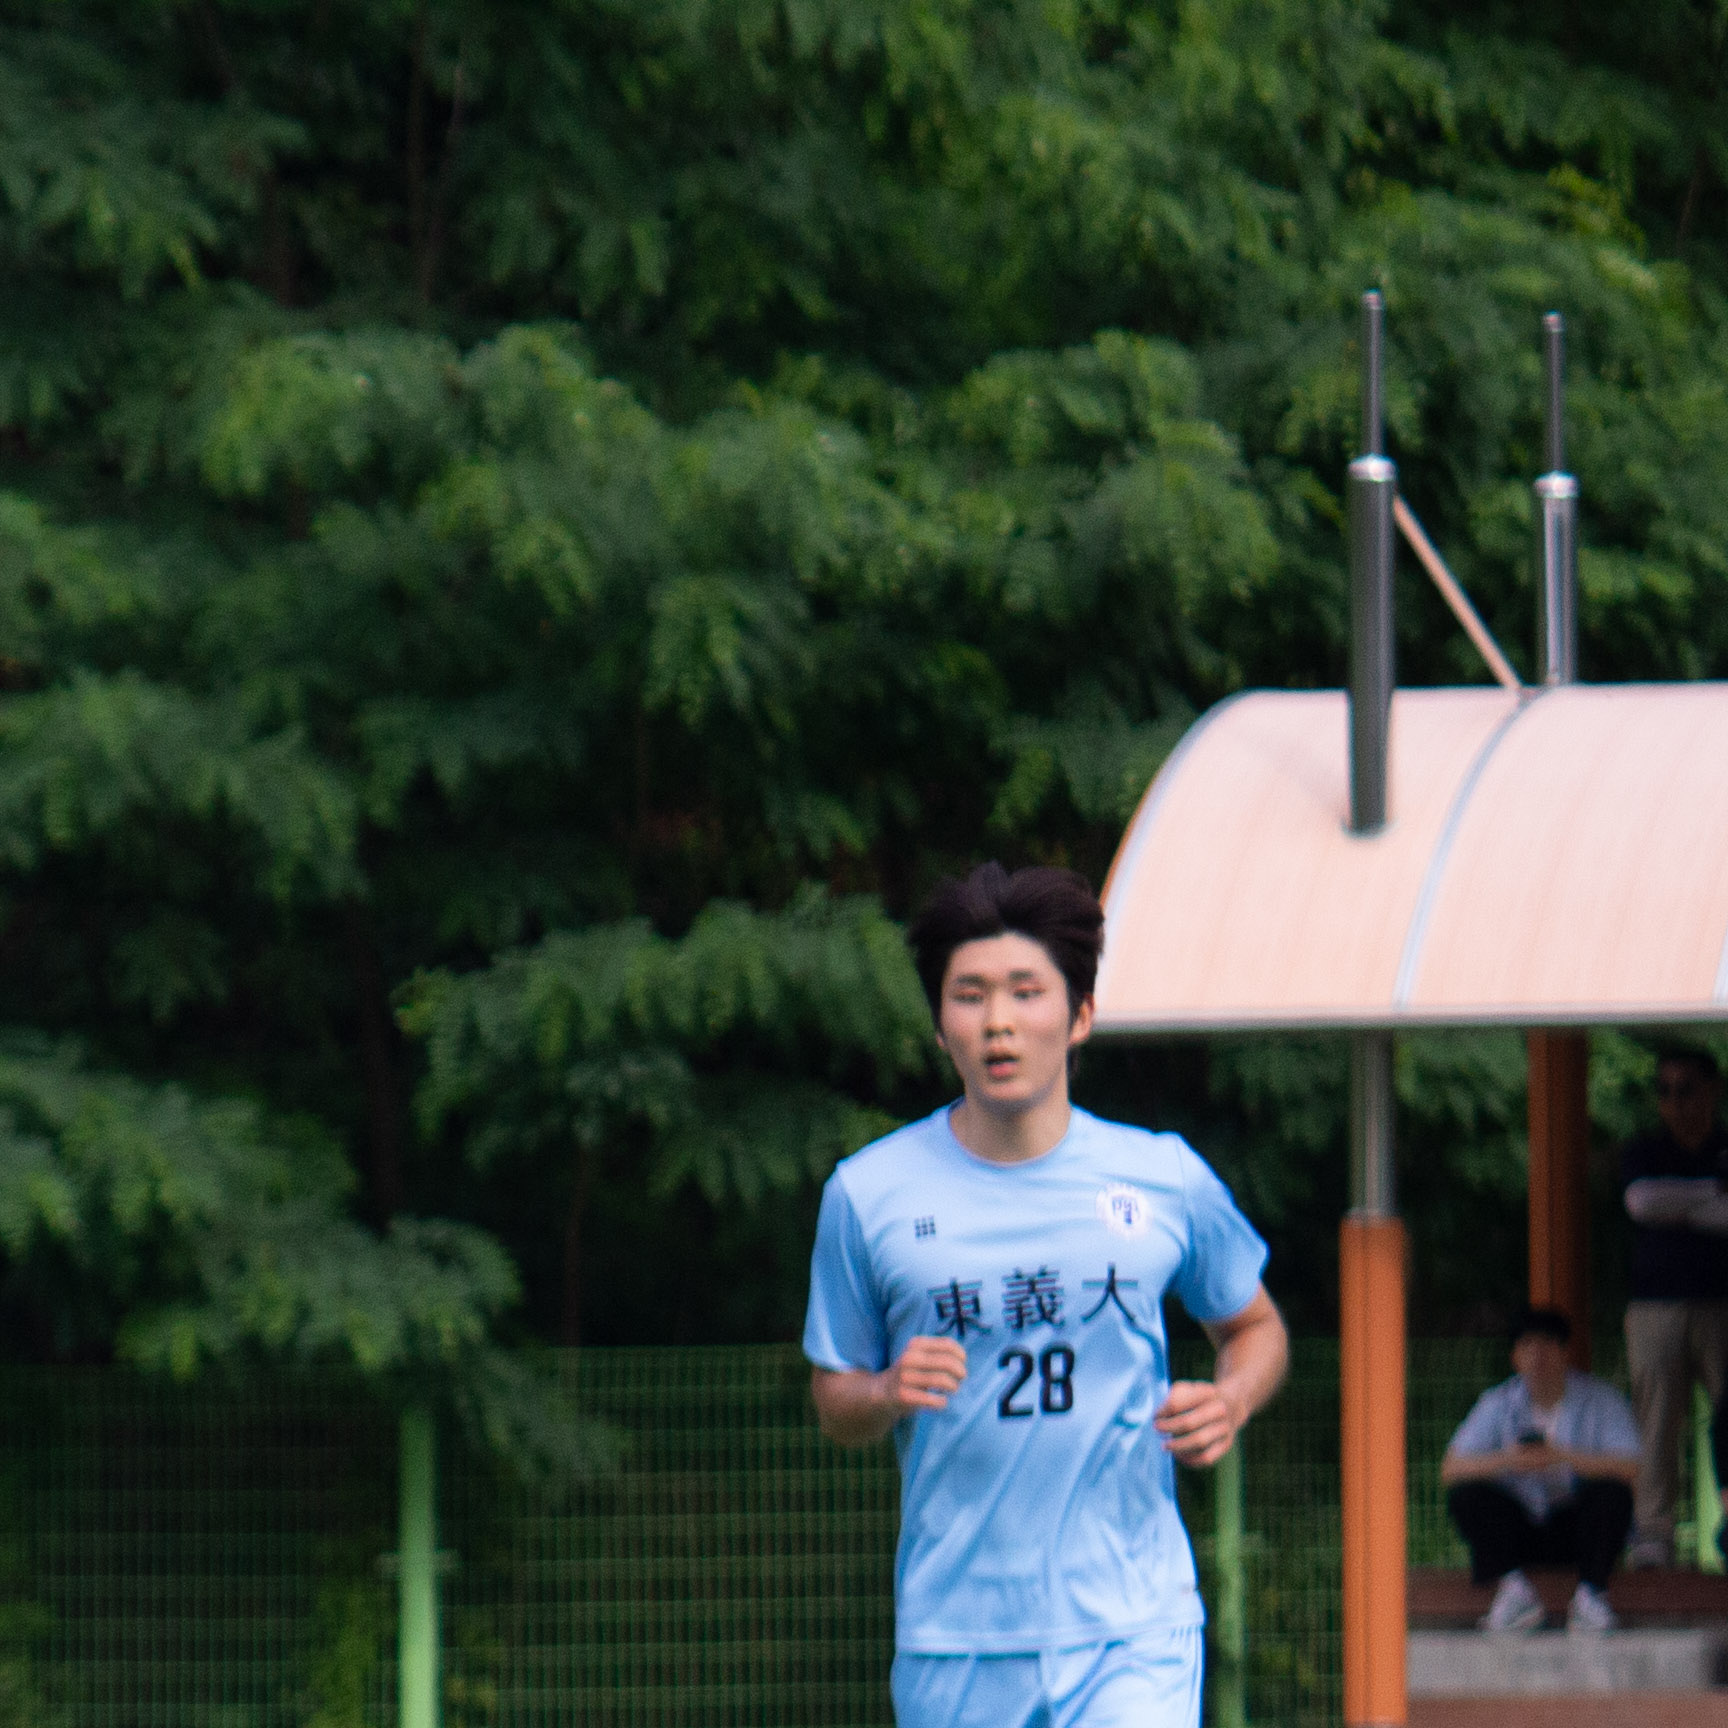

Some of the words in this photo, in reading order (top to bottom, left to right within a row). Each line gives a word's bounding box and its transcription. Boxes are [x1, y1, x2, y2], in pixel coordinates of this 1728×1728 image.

[928, 1262, 1139, 1337] 東義大
[997, 1343, 1076, 1418] 28
